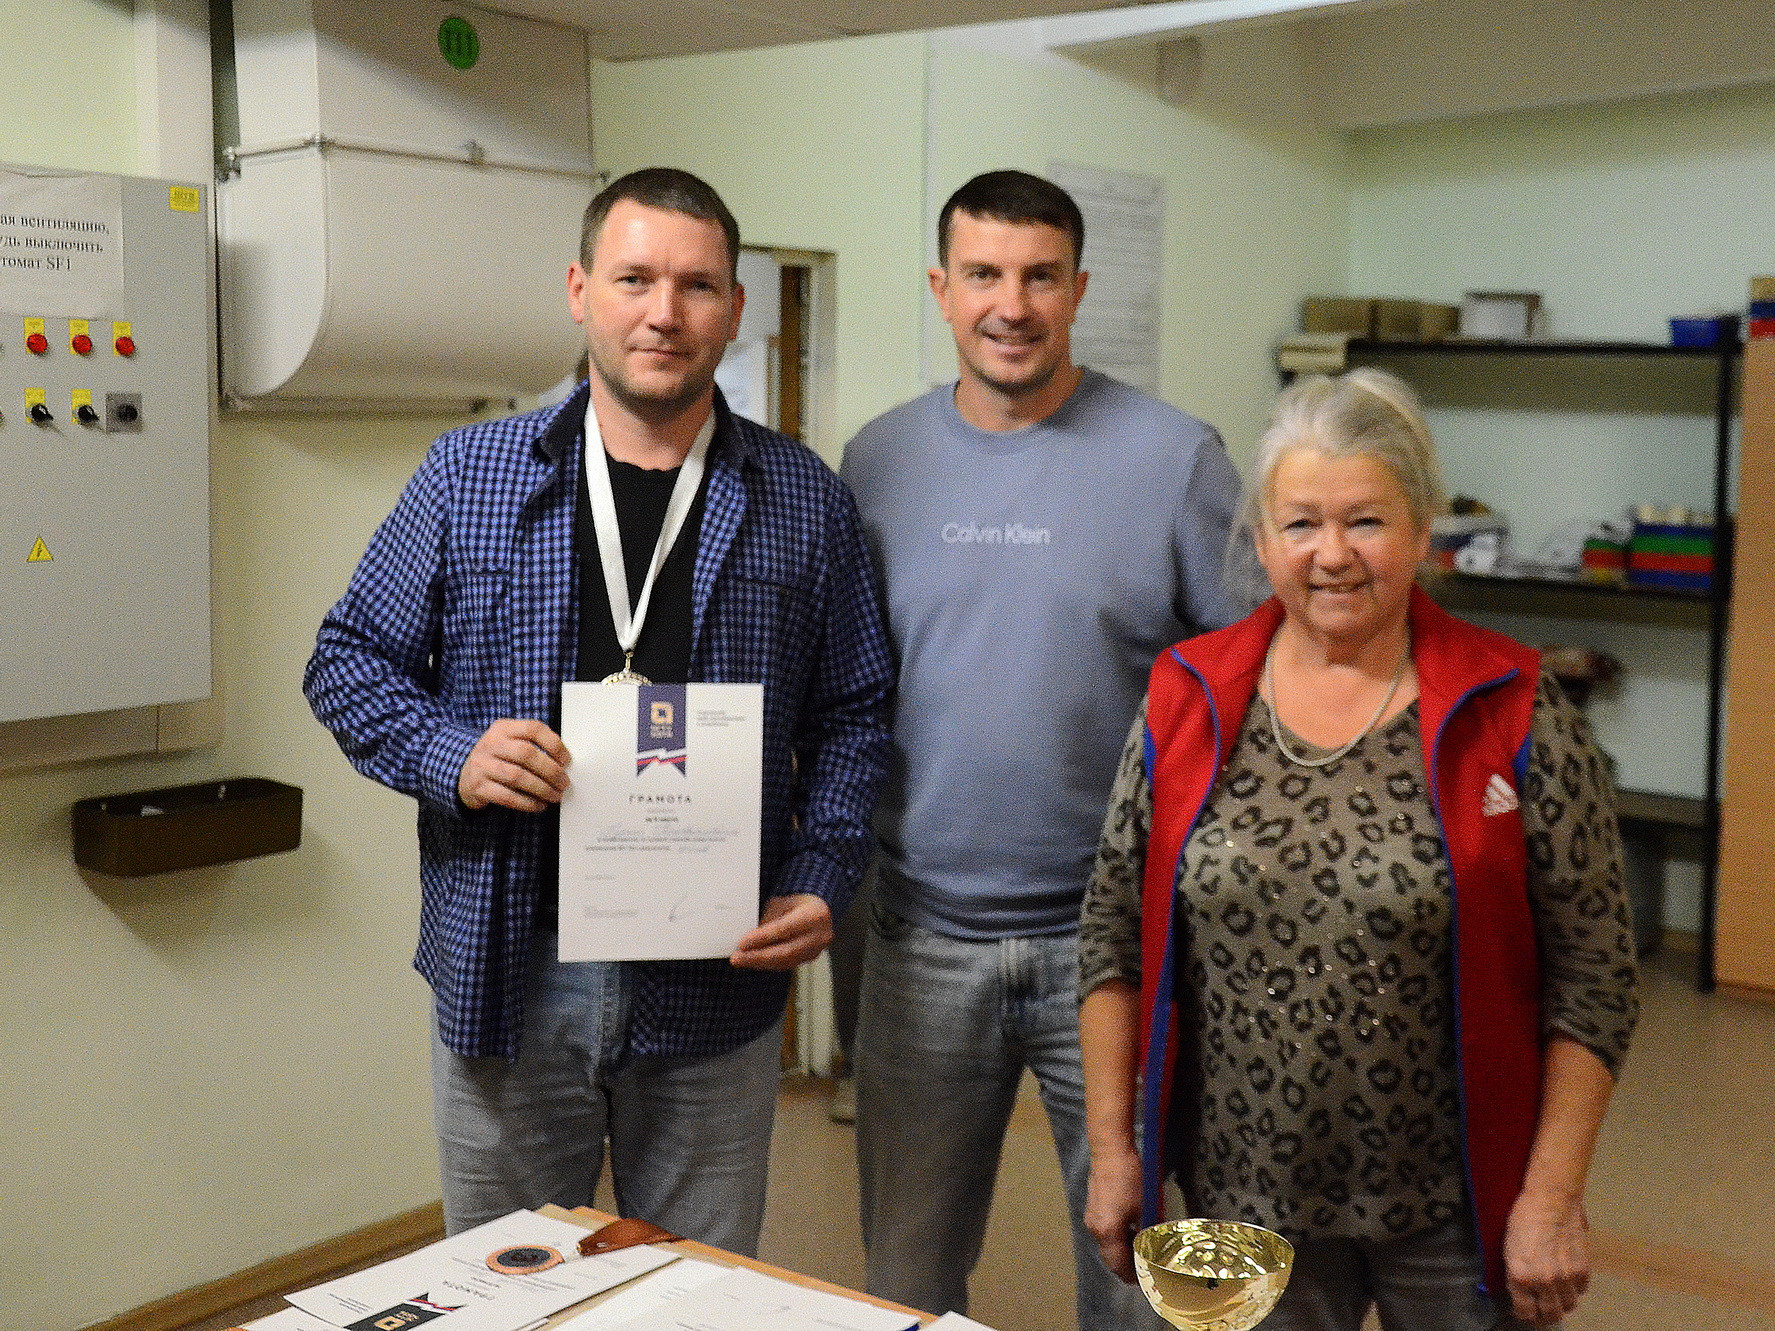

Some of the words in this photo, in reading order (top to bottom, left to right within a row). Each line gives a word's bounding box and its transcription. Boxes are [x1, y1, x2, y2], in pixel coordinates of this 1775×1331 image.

[21, 215, 110, 235] вентиляцию,
[25, 236, 104, 254] выключить
[46, 255, 72, 272] SF1
[941, 521, 1002, 545] Calvin
[1003, 521, 1051, 545] Klein
